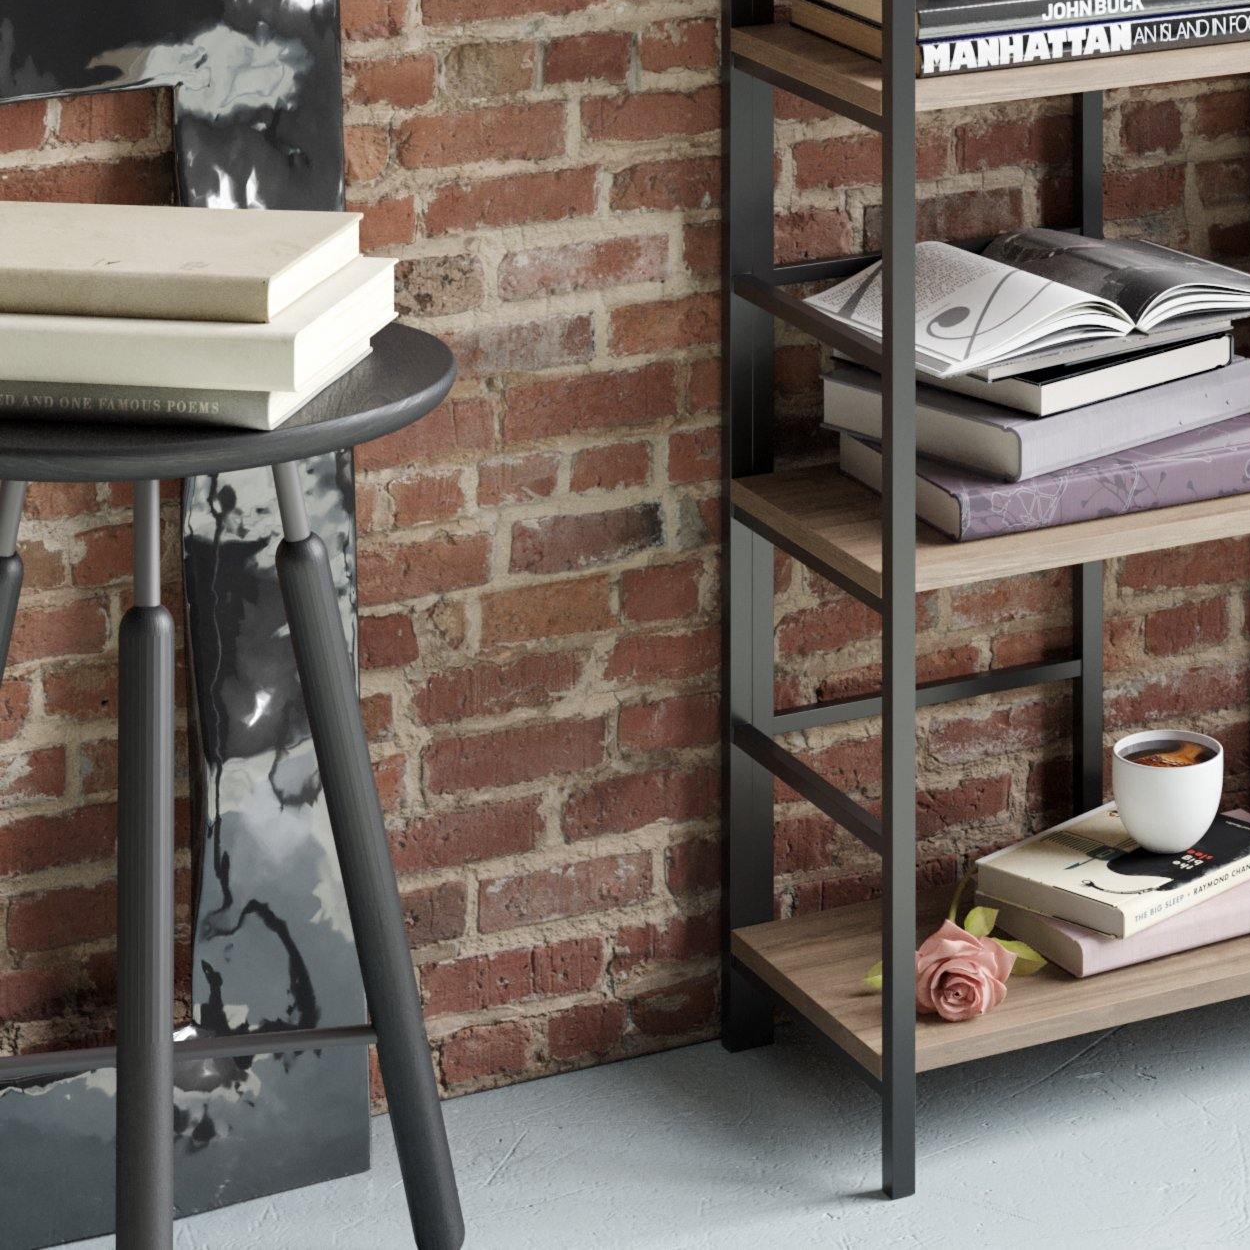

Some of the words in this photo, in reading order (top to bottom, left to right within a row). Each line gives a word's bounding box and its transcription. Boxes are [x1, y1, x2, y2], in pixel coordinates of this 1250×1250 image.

[1041, 1, 1094, 22] JOHN
[923, 22, 1132, 74] MANHATTAN
[1133, 25, 1157, 45] AN
[1160, 19, 1209, 42] ISLAND
[1211, 17, 1226, 37] IN
[22, 395, 54, 408] AND
[59, 397, 92, 411] ONE
[99, 399, 161, 413] FAMOUS
[166, 400, 220, 415] POEMS
[1134, 913, 1147, 923] THE
[1150, 906, 1162, 916] BIG
[1165, 894, 1185, 909] SLEEP
[1193, 873, 1229, 895] RAYMOND
